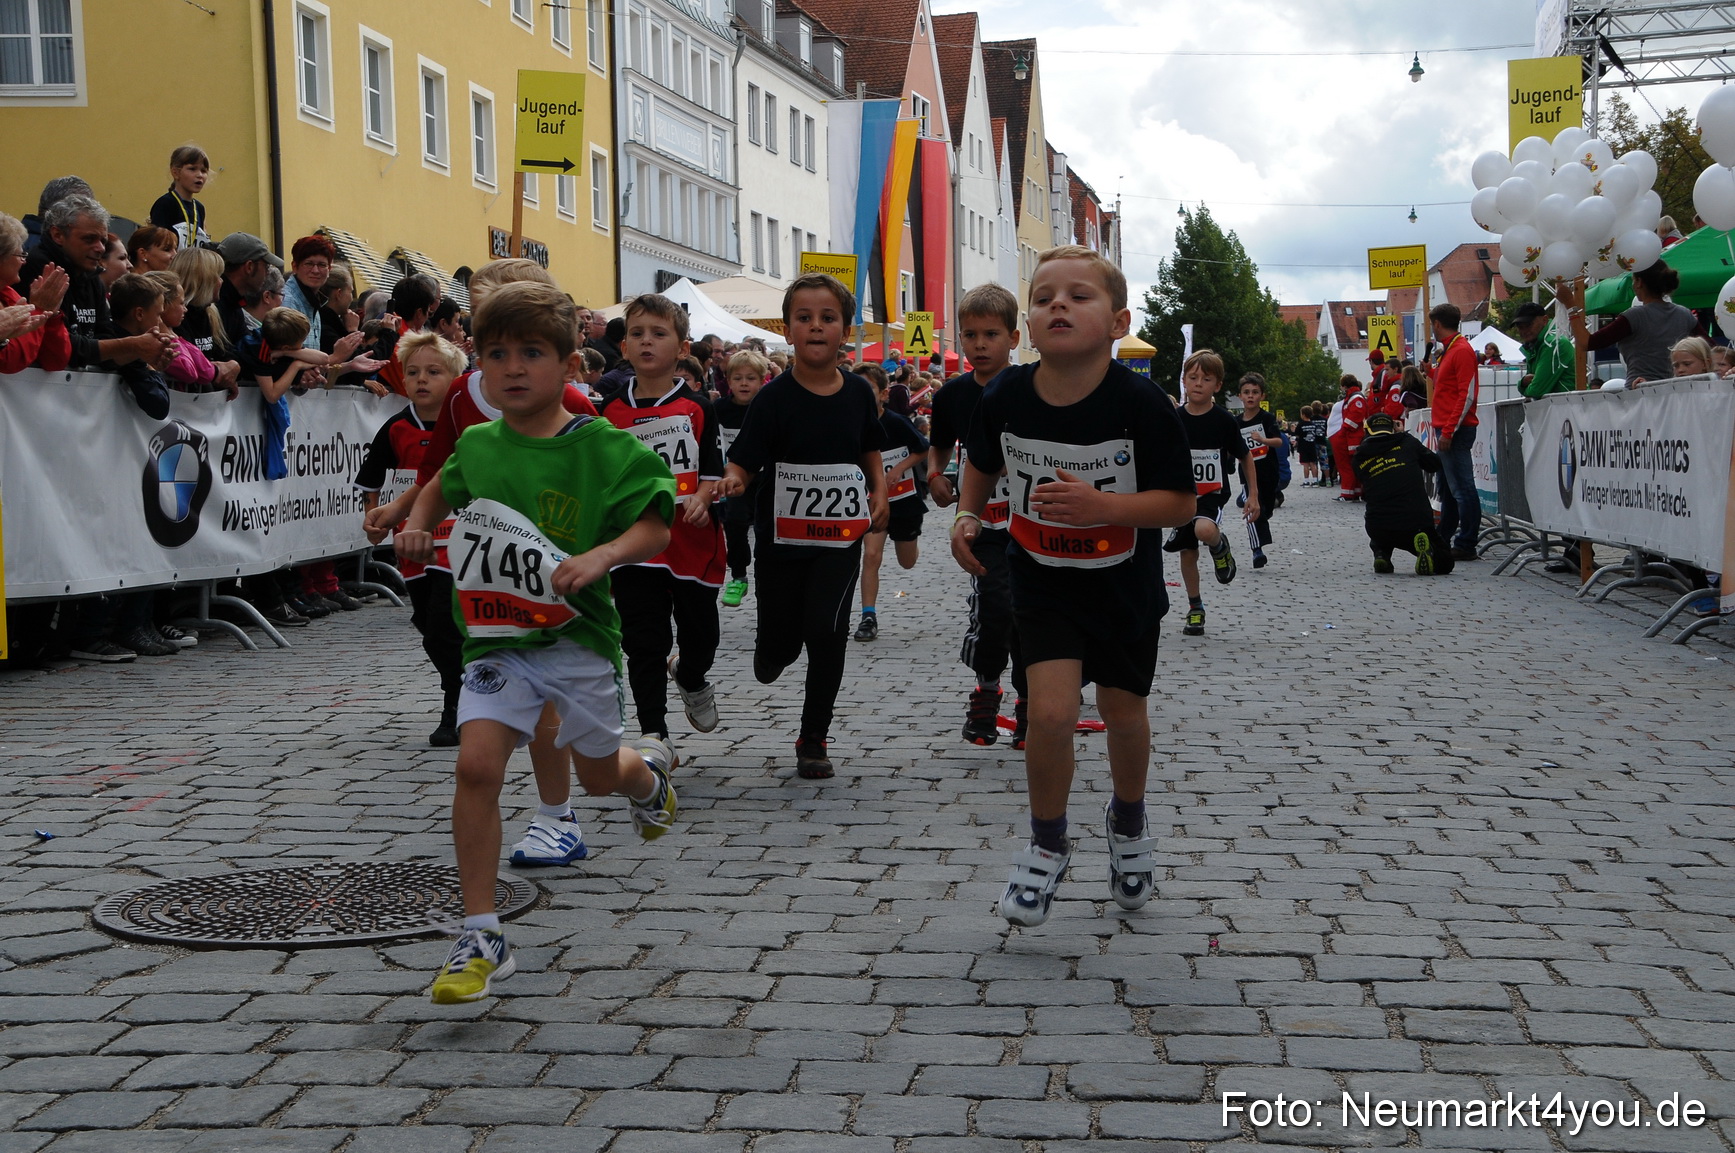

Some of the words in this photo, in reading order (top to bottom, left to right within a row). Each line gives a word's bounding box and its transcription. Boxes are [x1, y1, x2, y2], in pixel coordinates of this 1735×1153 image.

[1511, 85, 1580, 107] Jugend-
[519, 97, 582, 118] Jugend-
[1530, 106, 1561, 124] lauf
[536, 118, 565, 134] lauf
[803, 263, 852, 274] Schnupper-
[1371, 258, 1421, 268] Schnupper-
[1389, 269, 1405, 279] lauf
[908, 313, 931, 322] Block
[1371, 317, 1397, 327] Block
[910, 325, 926, 347] A
[1376, 329, 1393, 352] A
[637, 425, 680, 441] Neumarkt
[1006, 445, 1040, 466] PARTL
[1044, 455, 1109, 470] Neumarkt
[1579, 430, 1607, 467] BMW
[778, 471, 809, 481] PARTL
[812, 472, 853, 482] Neumarkt
[222, 497, 277, 536] Weniger
[327, 486, 350, 517] Mehr
[785, 487, 860, 518] 7223
[458, 509, 488, 528] PARTL
[807, 523, 841, 537] Noah
[1039, 530, 1095, 554] Lukas
[457, 531, 545, 597] 7148
[470, 597, 534, 624] Tobias
